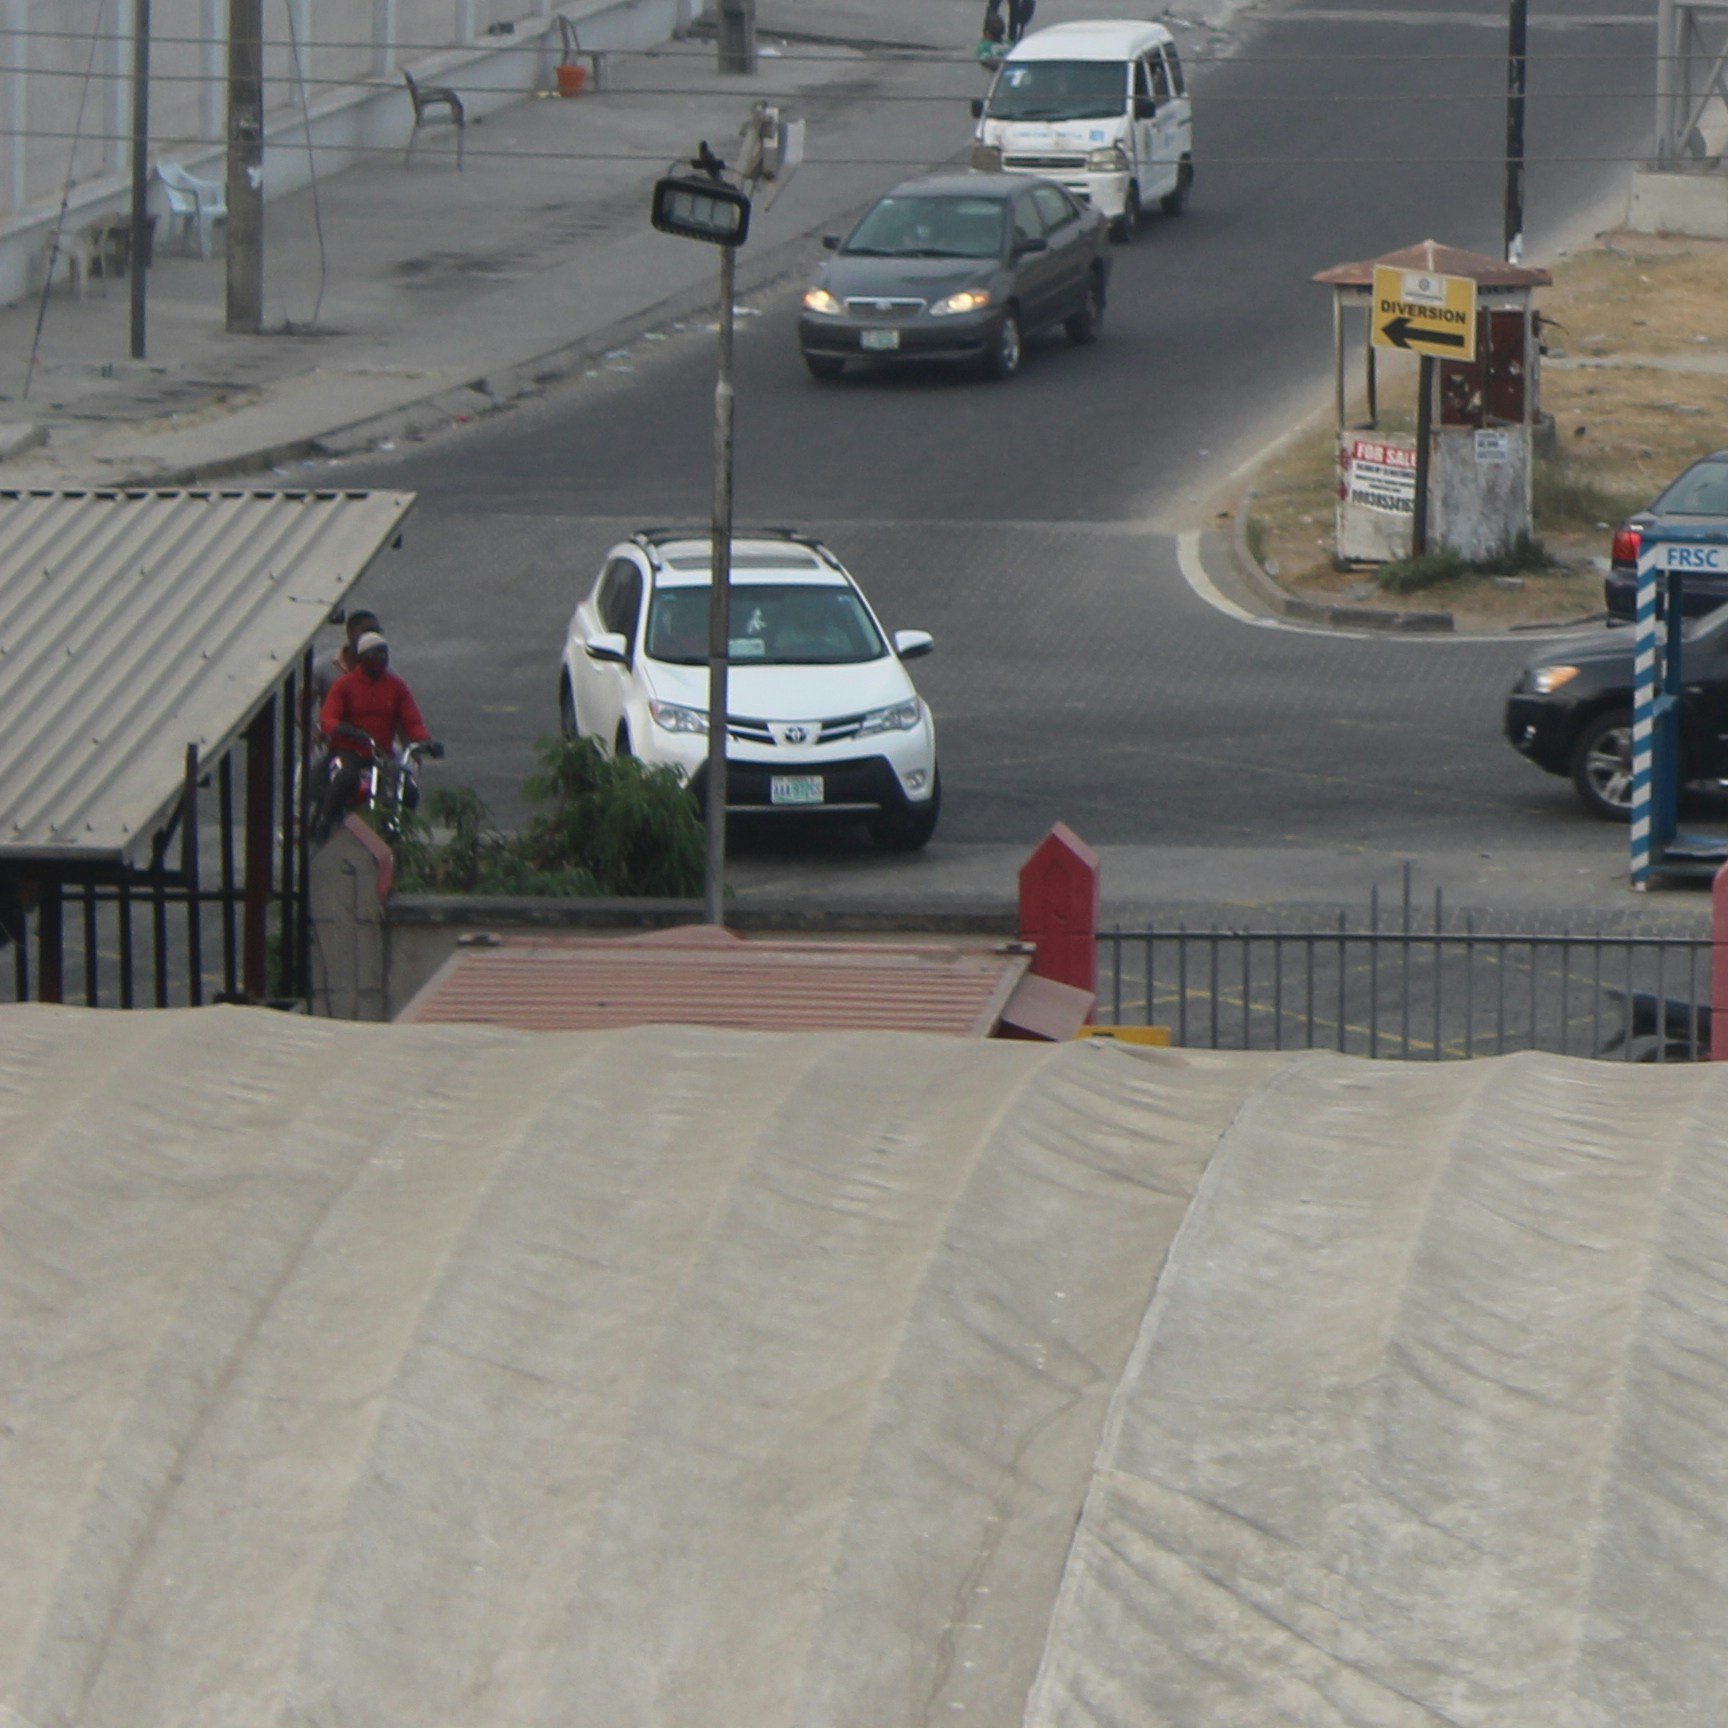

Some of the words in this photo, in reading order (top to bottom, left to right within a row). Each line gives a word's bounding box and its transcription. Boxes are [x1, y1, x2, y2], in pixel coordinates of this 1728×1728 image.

[1381, 300, 1466, 324] DIVERSION
[1357, 442, 1384, 463] FOR
[1667, 548, 1718, 568] FRSC
